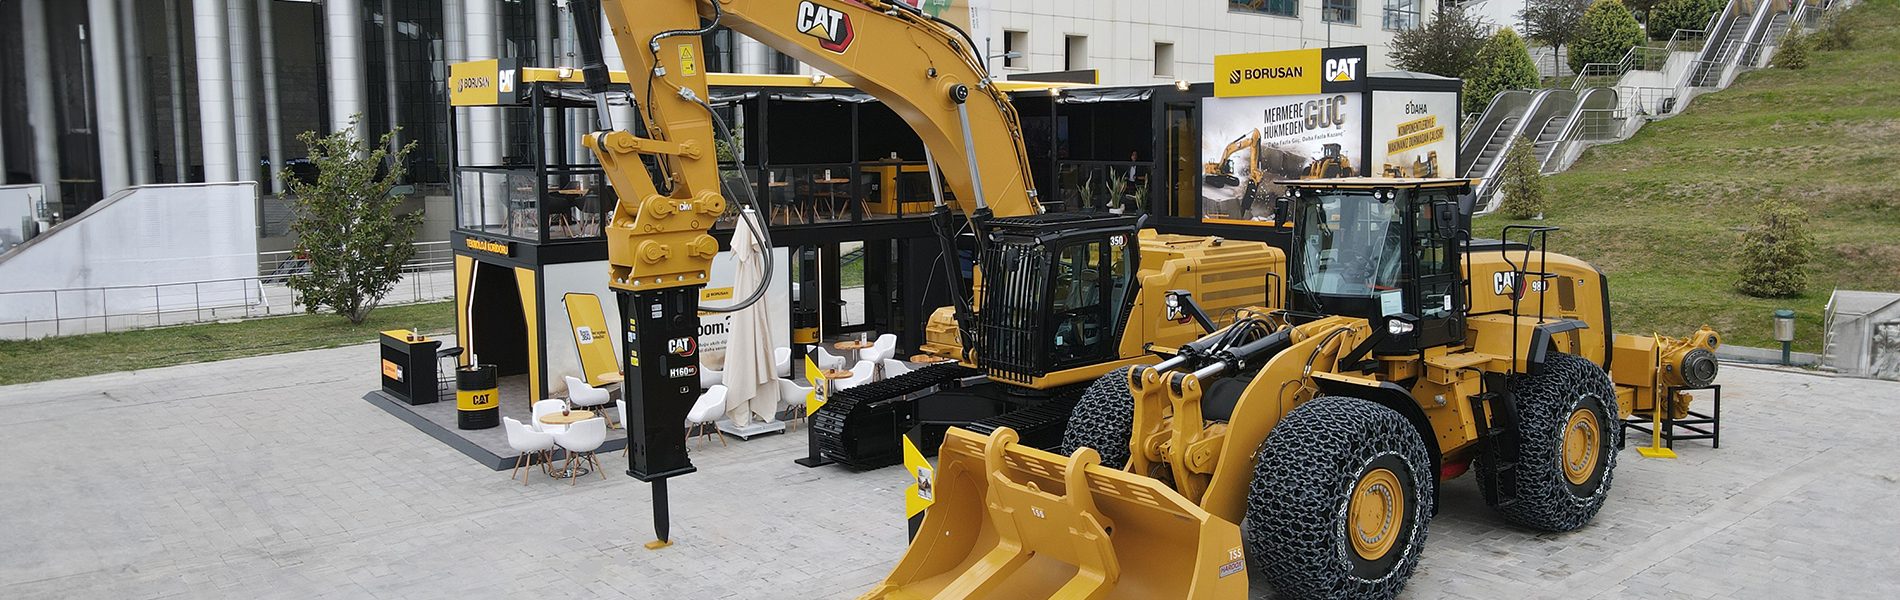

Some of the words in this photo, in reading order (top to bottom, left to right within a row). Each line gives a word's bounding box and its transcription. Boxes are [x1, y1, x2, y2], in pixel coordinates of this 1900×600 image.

[797, 1, 843, 41] CAT
[1244, 66, 1303, 80] BORUSAN
[1325, 58, 1358, 82] CAT
[464, 76, 490, 89] BORUSAN
[499, 69, 515, 92] CAT
[1264, 102, 1304, 124] MERMERE
[1304, 94, 1346, 130] GÜÇ
[1264, 120, 1304, 140] HÜKMEDEN
[1110, 236, 1123, 246] 350
[668, 338, 689, 354] CAT
[670, 367, 688, 378] H160
[472, 394, 490, 406] CAT
[1229, 548, 1242, 560] TSS
